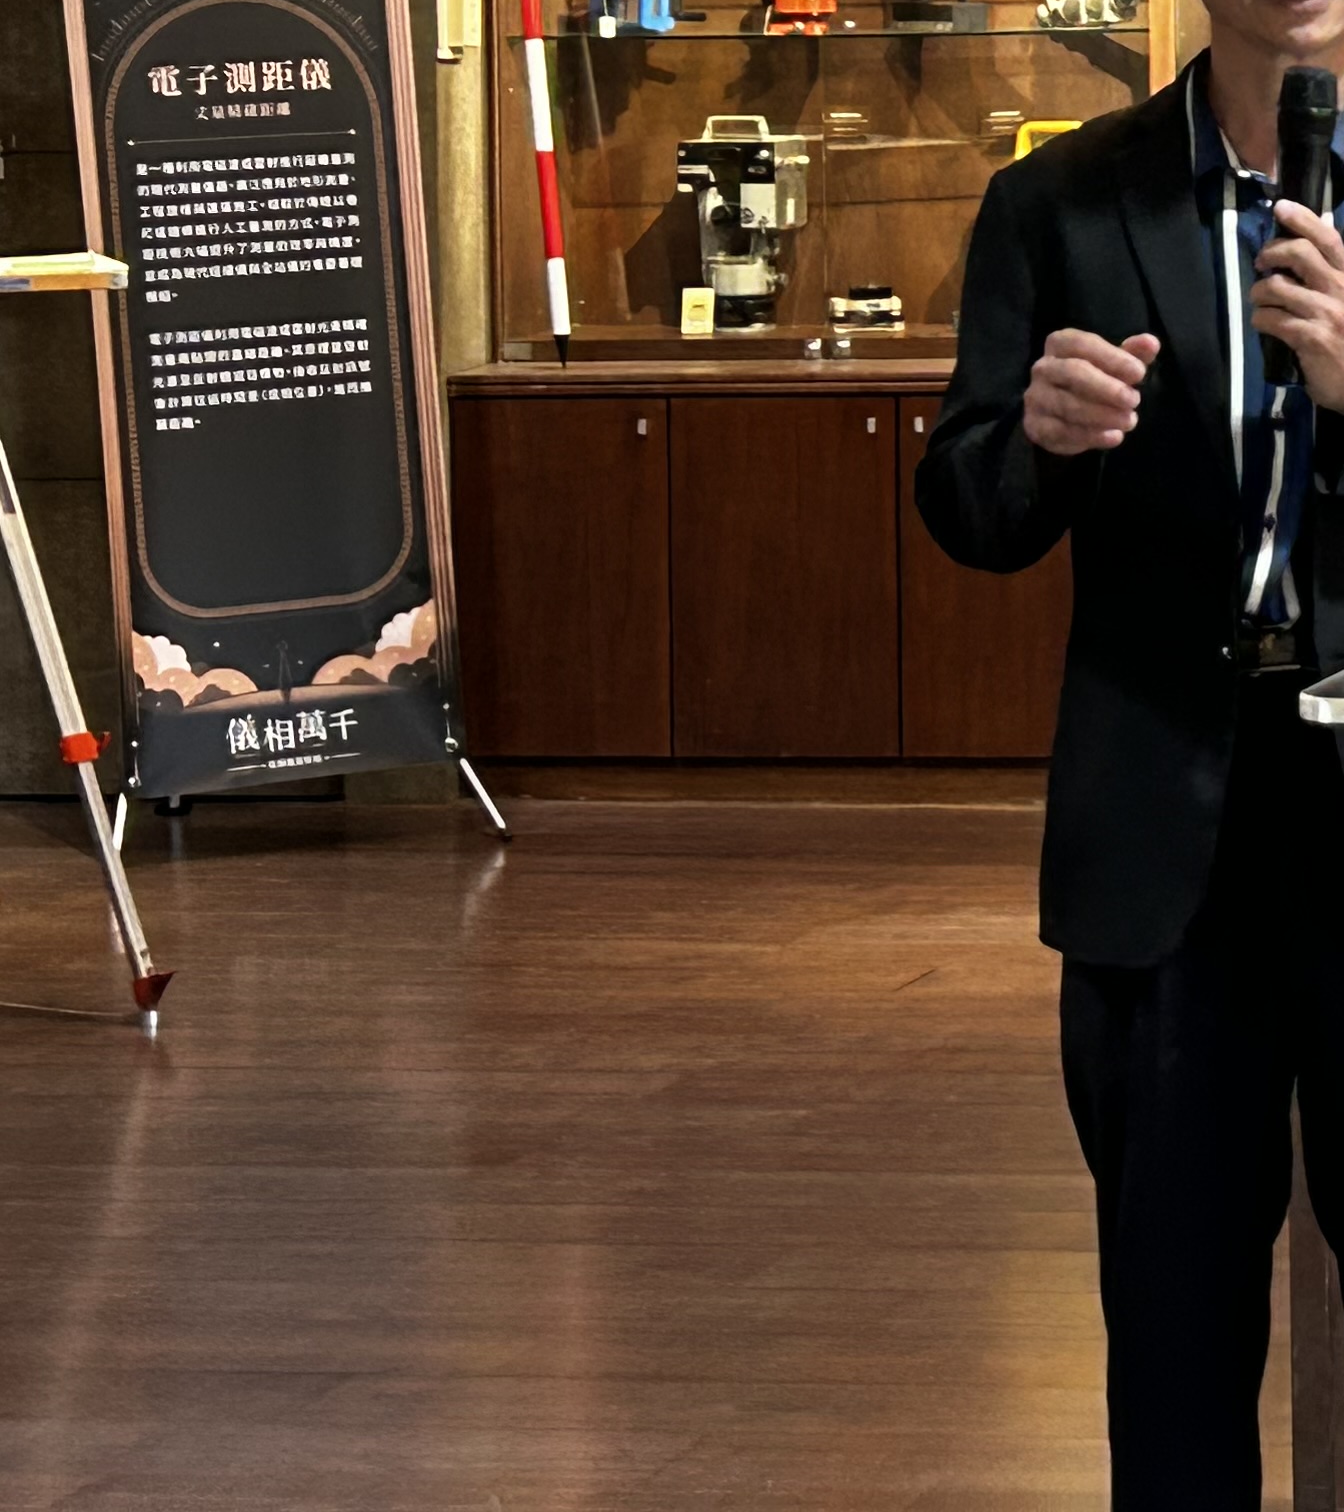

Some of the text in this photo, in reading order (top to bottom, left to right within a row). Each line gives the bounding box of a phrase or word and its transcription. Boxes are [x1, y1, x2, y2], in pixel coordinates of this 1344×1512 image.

[147, 58, 332, 97] 電子測距儀
[226, 707, 359, 755] 儀相萬千
